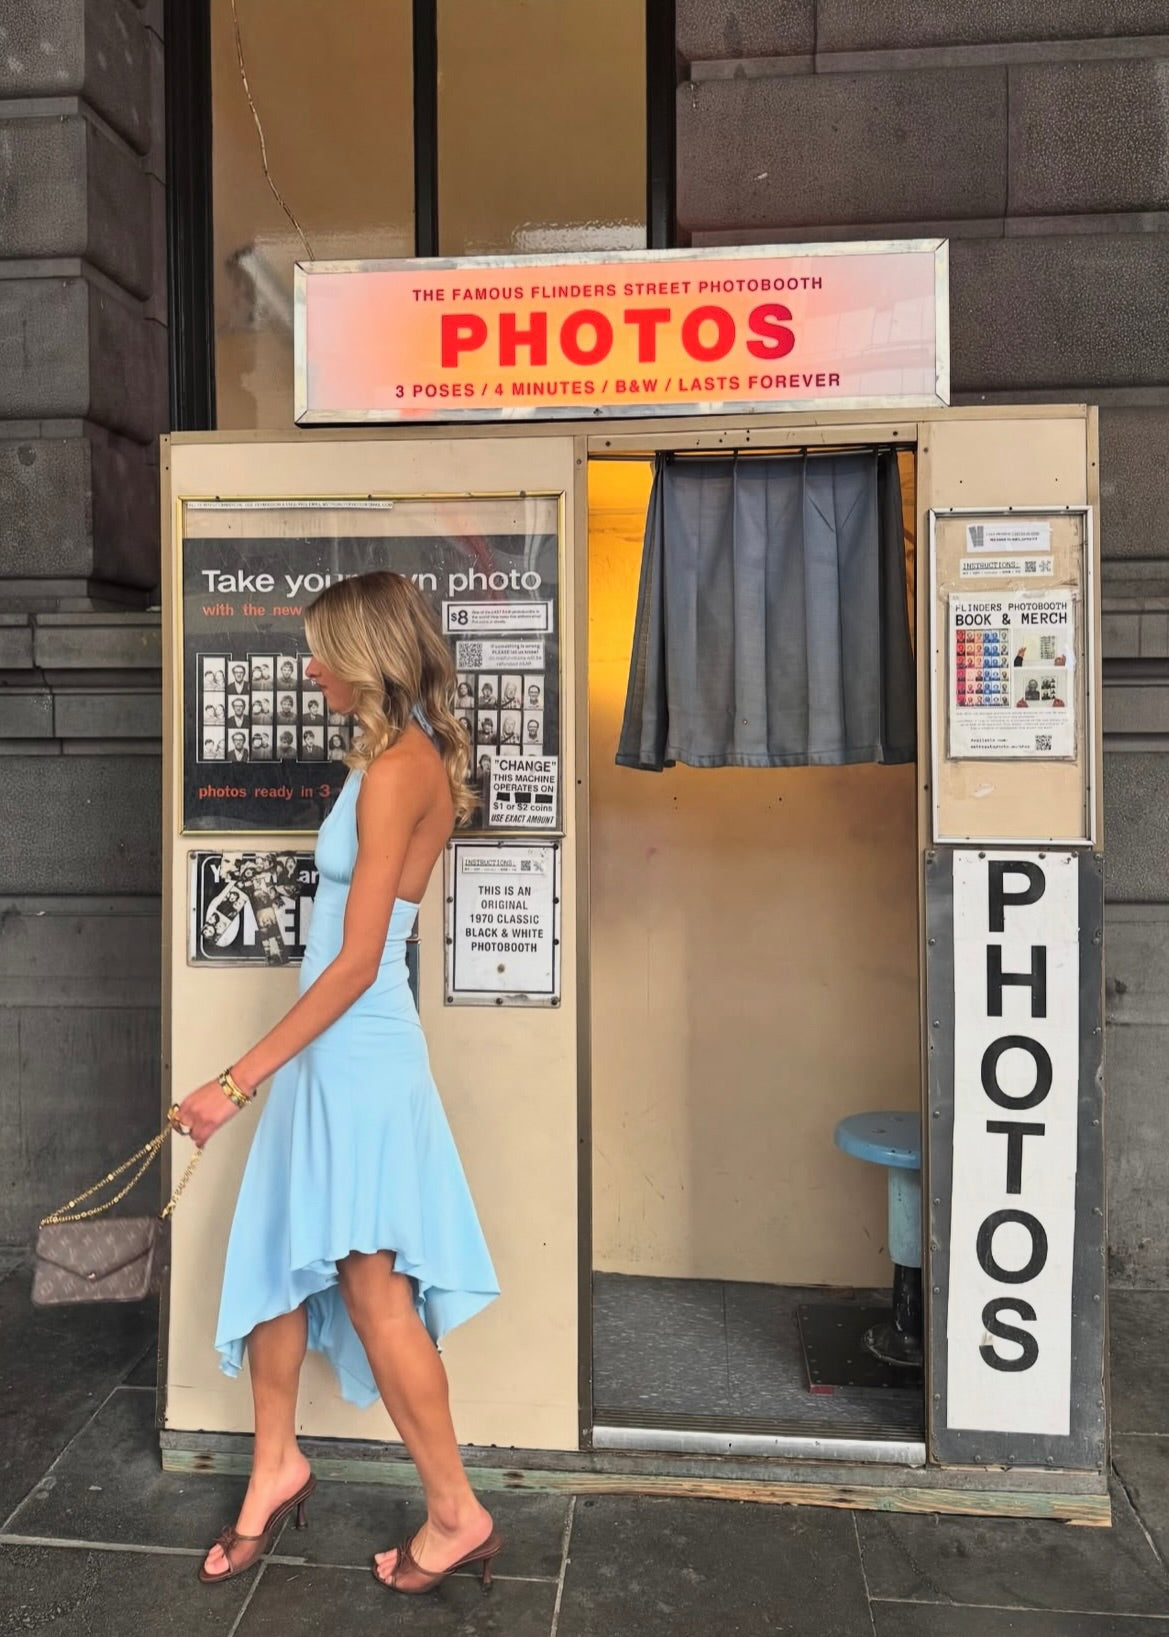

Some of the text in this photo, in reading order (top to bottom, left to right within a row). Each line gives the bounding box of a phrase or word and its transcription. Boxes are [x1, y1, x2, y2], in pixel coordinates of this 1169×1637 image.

[413, 277, 823, 301] THE FAMOUS FLINDERS STREET PHOTOBOOTH
[441, 303, 795, 368] PHOTOS
[395, 373, 840, 398] 3 POSES / 4 MINUTES / B&W / LASTS FOREVER
[202, 570, 275, 593] Take
[284, 572, 359, 598] you
[449, 568, 542, 597] photo
[202, 603, 303, 616] with the new
[955, 602, 1067, 612] FLINDERS PHOTOBOOTH
[451, 610, 469, 626] $8
[955, 612, 1067, 626] BOOK & MERCH
[495, 760, 556, 773] "CHANGE"
[493, 774, 555, 783] THIS MACHINE
[198, 784, 247, 800] photos
[255, 785, 294, 801] ready
[301, 785, 313, 798] in
[319, 784, 331, 798] 3
[493, 783, 554, 793] OPERATES ON
[493, 802, 503, 810] $1
[517, 803, 528, 811] $2
[491, 814, 554, 824] USE EXACT AMOUNT
[478, 886, 531, 896] THIS IS AN
[481, 899, 528, 910] ORIGINAL
[470, 914, 539, 925] 1970 CLASSIC
[465, 928, 544, 939] BLACK & WHITE
[471, 942, 537, 952] PHOTOBOOTH
[976, 860, 1053, 1372] PHOTOS
